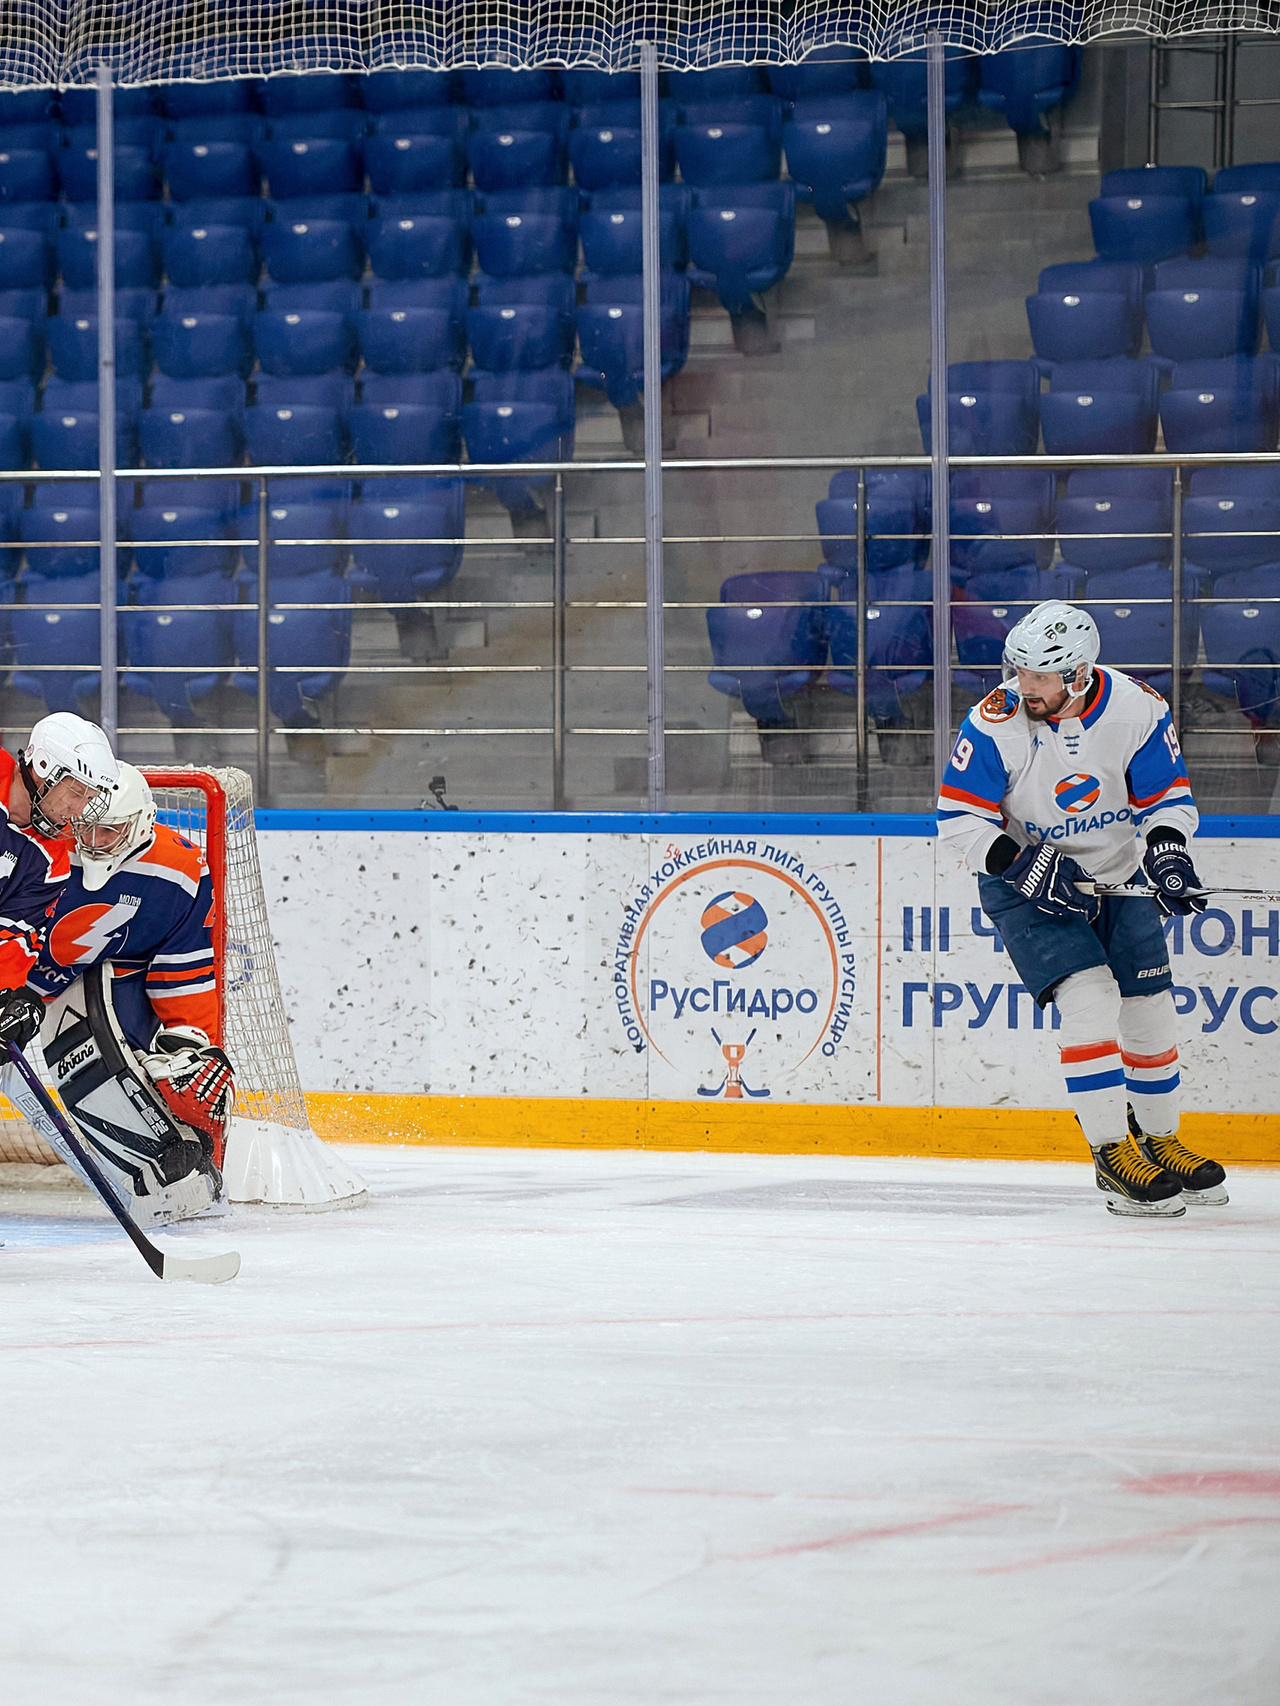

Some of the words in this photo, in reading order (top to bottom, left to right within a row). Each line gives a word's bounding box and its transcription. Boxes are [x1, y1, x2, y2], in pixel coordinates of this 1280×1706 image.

[650, 837, 758, 888] ХОККЕЙНАЯ
[760, 844, 807, 878] ЛИГА
[1020, 843, 1057, 898] WARRIO
[805, 872, 853, 949] ГРУППЫ
[614, 884, 656, 1053] КОРПОРАТИВНАЯ
[1136, 964, 1171, 979] BAUE
[650, 979, 819, 1021] РусГидро
[821, 952, 857, 1058] РУСГИДРО
[121, 1076, 162, 1127] AIR
